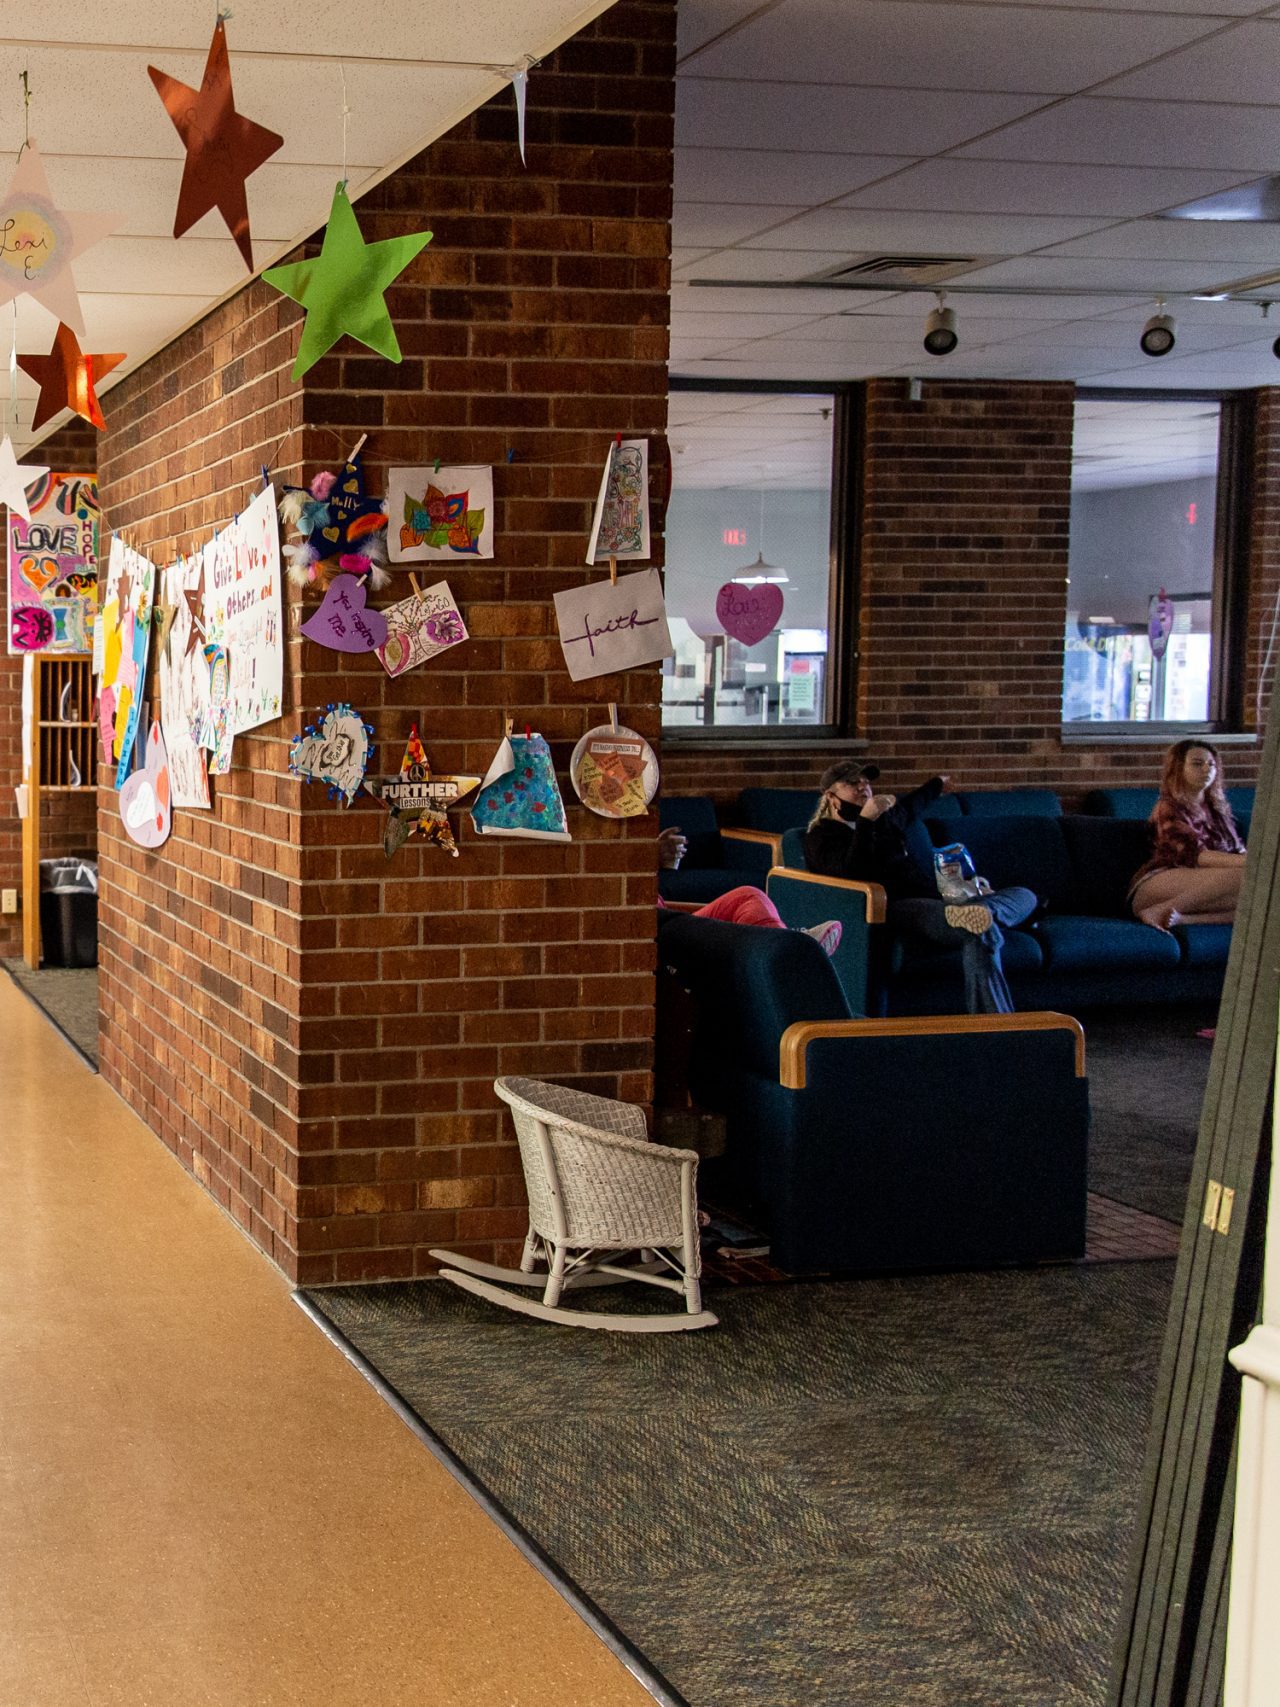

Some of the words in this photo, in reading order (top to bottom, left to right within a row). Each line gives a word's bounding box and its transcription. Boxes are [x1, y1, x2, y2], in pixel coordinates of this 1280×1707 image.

[13, 525, 78, 555] LOVE
[82, 520, 96, 565] HOPE
[563, 609, 659, 657] faith
[381, 783, 459, 799] FURTHER
